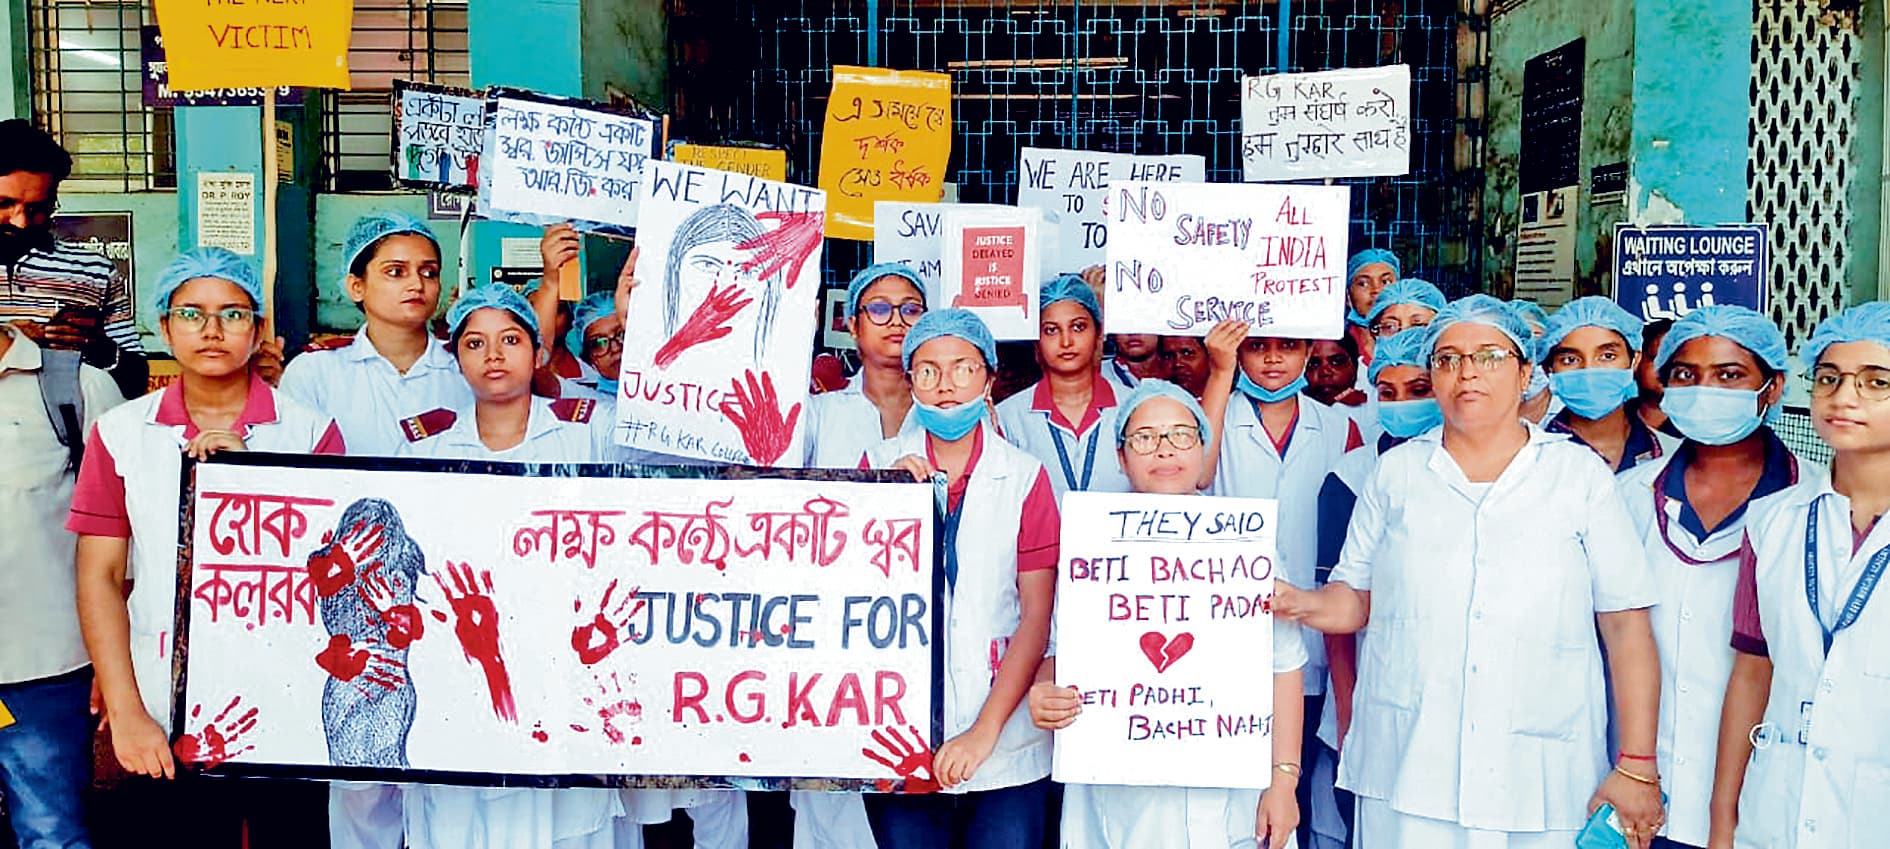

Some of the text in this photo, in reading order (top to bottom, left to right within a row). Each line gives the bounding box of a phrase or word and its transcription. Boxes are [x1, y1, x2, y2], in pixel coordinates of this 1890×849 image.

[208, 24, 311, 48] VICTIM
[1294, 78, 1335, 100] KAR
[833, 97, 861, 121] এ
[1268, 106, 1295, 126] तुम
[1303, 92, 1348, 122] संघर्ष
[499, 106, 542, 132] লক্ষ
[599, 121, 647, 147] একটি
[853, 131, 904, 160] দর্শক
[1243, 133, 1277, 162] हम
[1352, 130, 1391, 152] साथ
[716, 160, 771, 176] GENDER
[1025, 160, 1182, 190] WE ARE HERE
[601, 177, 639, 201] কর
[652, 167, 822, 224] WE WANT
[838, 168, 880, 197] সেও
[1063, 195, 1084, 213] TO
[1275, 195, 1313, 225] ALL
[897, 210, 942, 237] SAV
[1120, 187, 1166, 224] NO
[1174, 213, 1253, 250] SAFETY
[976, 235, 1013, 246] JUSTICE
[1082, 222, 1107, 248] TO
[1624, 236, 1755, 255] WAITING LOUNGE
[972, 249, 1014, 259] DELAYED
[1256, 236, 1326, 269] INDIA
[1622, 257, 1754, 276] এখানে অপেক্ষা করুন
[974, 276, 1011, 286] JUSTICE
[988, 262, 998, 273] IS
[974, 288, 1011, 299] DENIED
[1116, 260, 1274, 329] NO SERVICE
[1250, 272, 1338, 295] PROTEST
[624, 371, 743, 412] JUSTICE
[201, 492, 335, 557] হোক
[514, 510, 626, 568] লক্ষ
[734, 495, 850, 567] একটি
[862, 518, 922, 578] স্বর
[1109, 510, 1264, 540] THEY SAID
[1070, 556, 1272, 584] BETI BACHAO
[194, 564, 315, 630] কলরব
[1108, 593, 1271, 624] BETI PADA
[629, 591, 929, 649] JUSTICE FOR
[1128, 714, 1207, 740] BACHI
